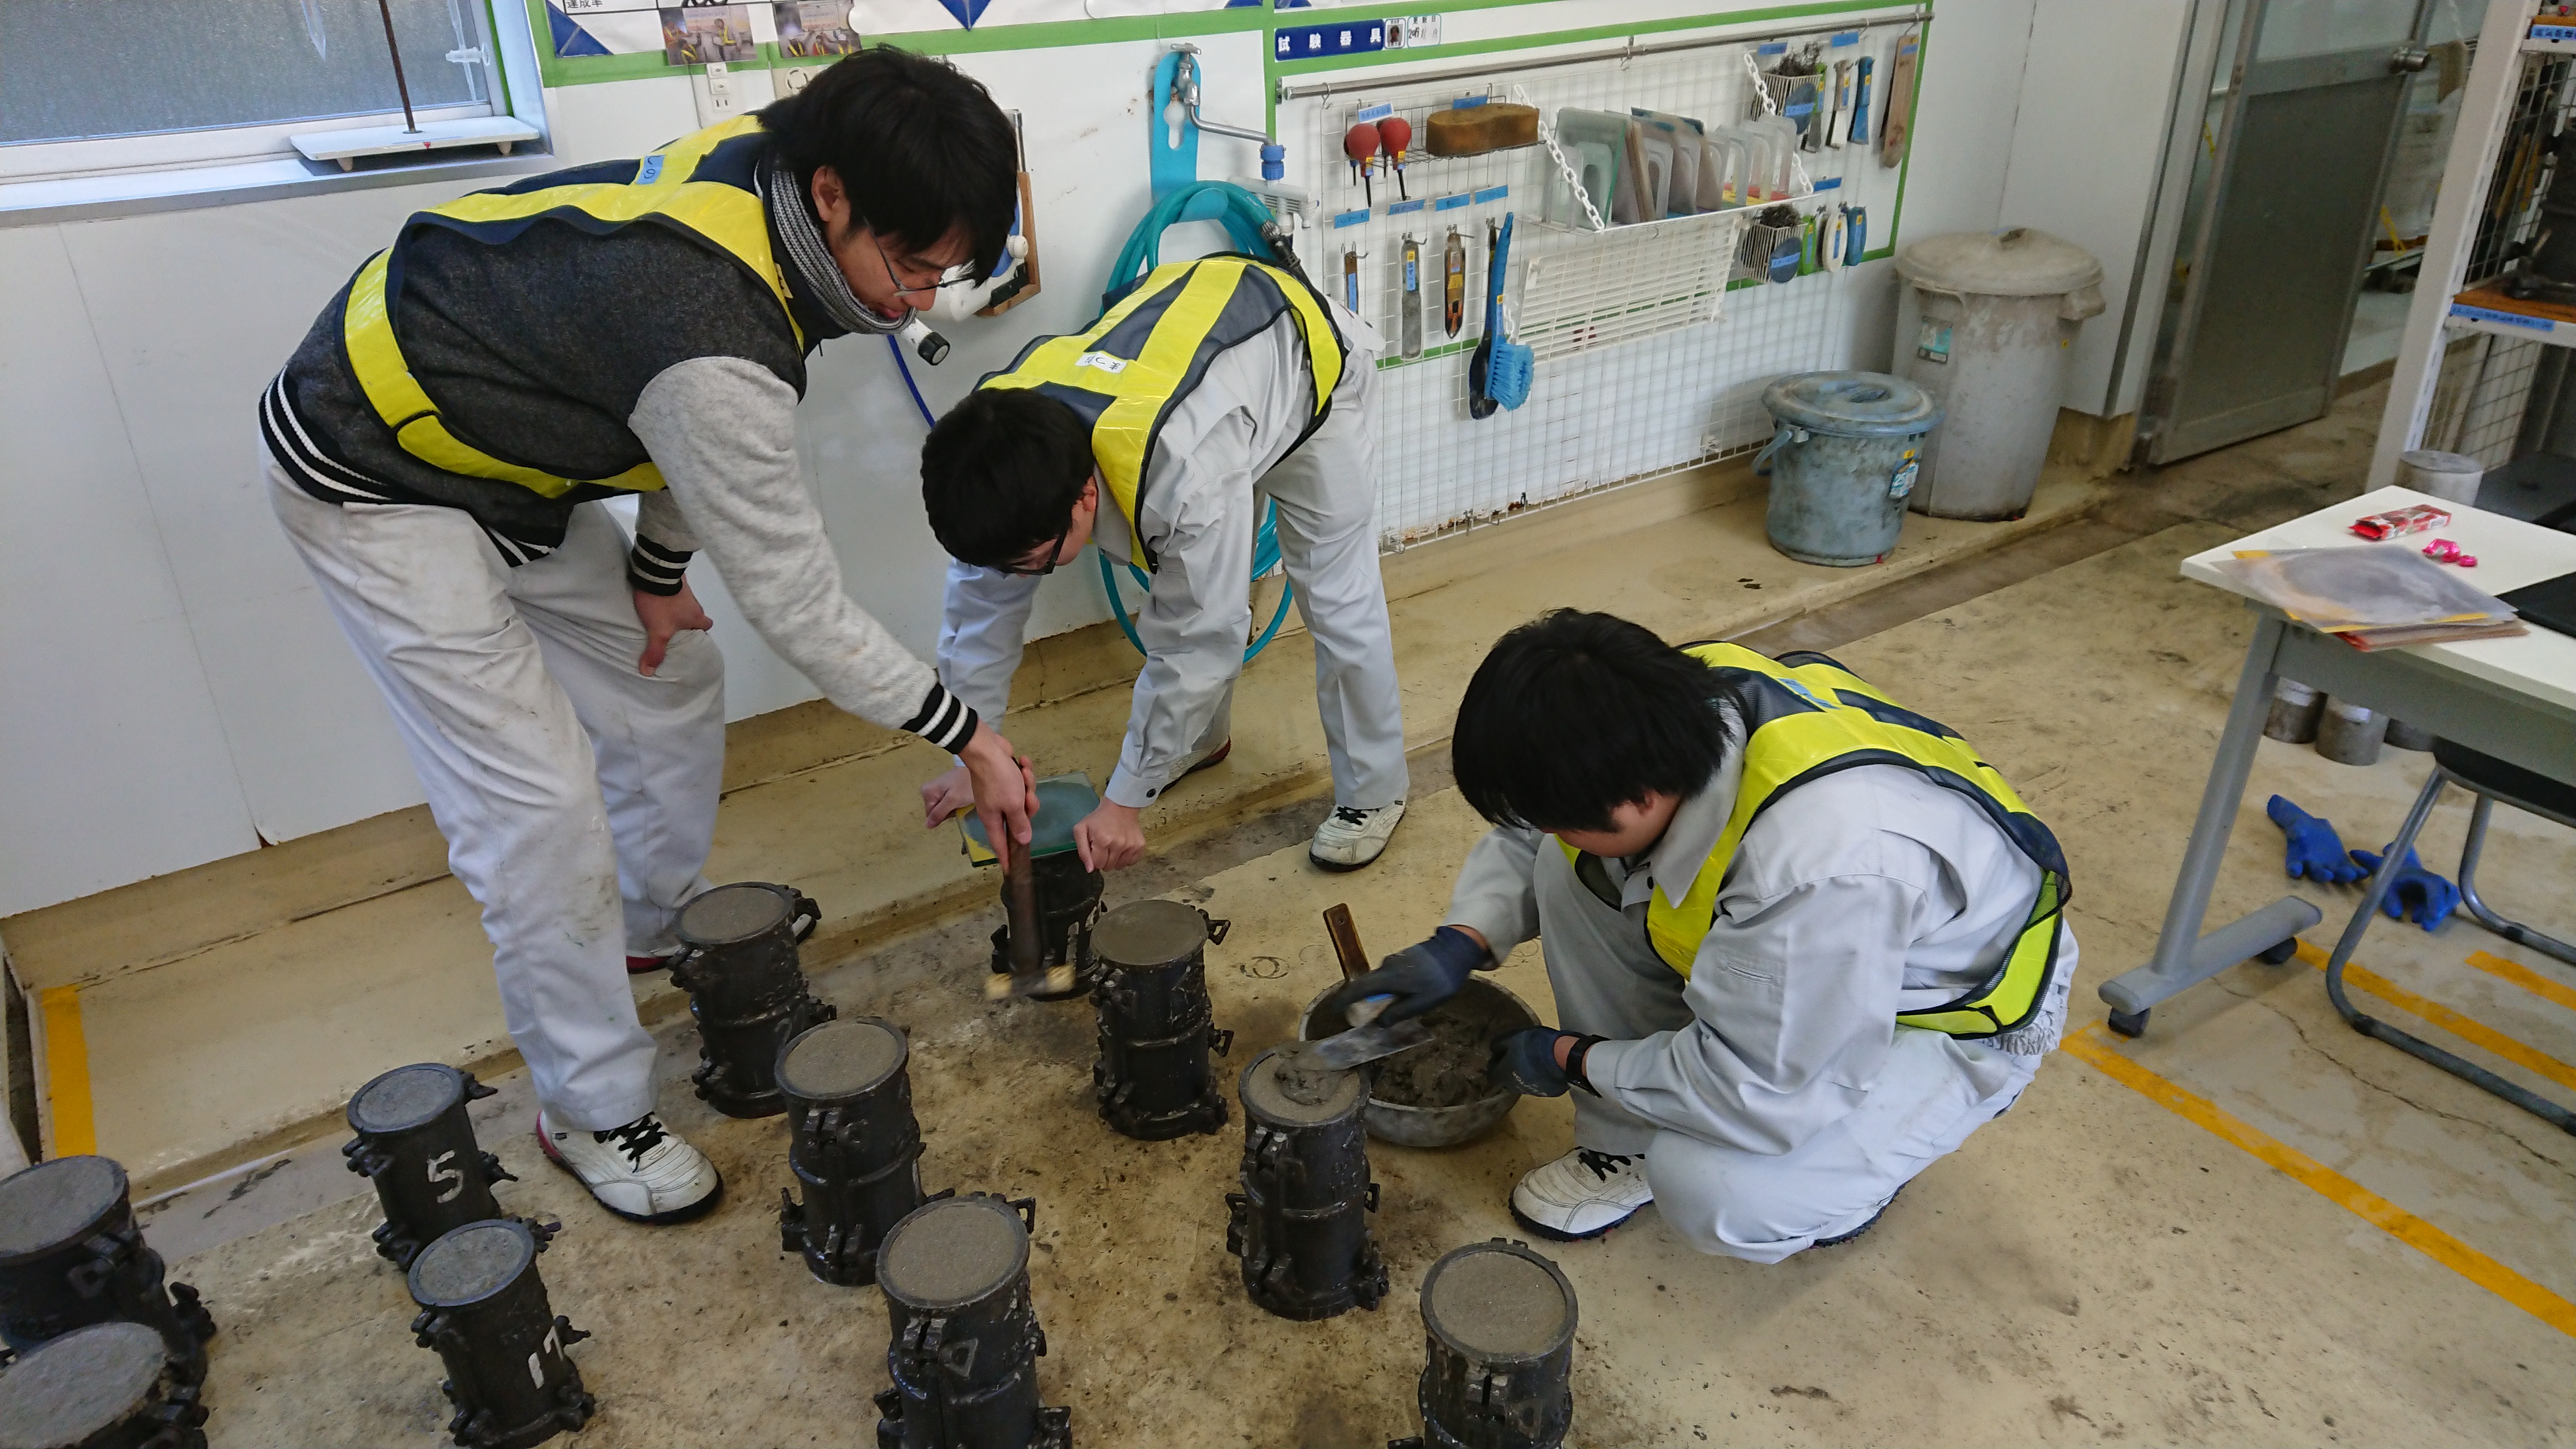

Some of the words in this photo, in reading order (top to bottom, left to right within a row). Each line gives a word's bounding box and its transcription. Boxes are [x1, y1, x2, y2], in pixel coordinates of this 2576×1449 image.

[1278, 28, 1382, 52] 試験器具
[427, 1149, 463, 1204] 5
